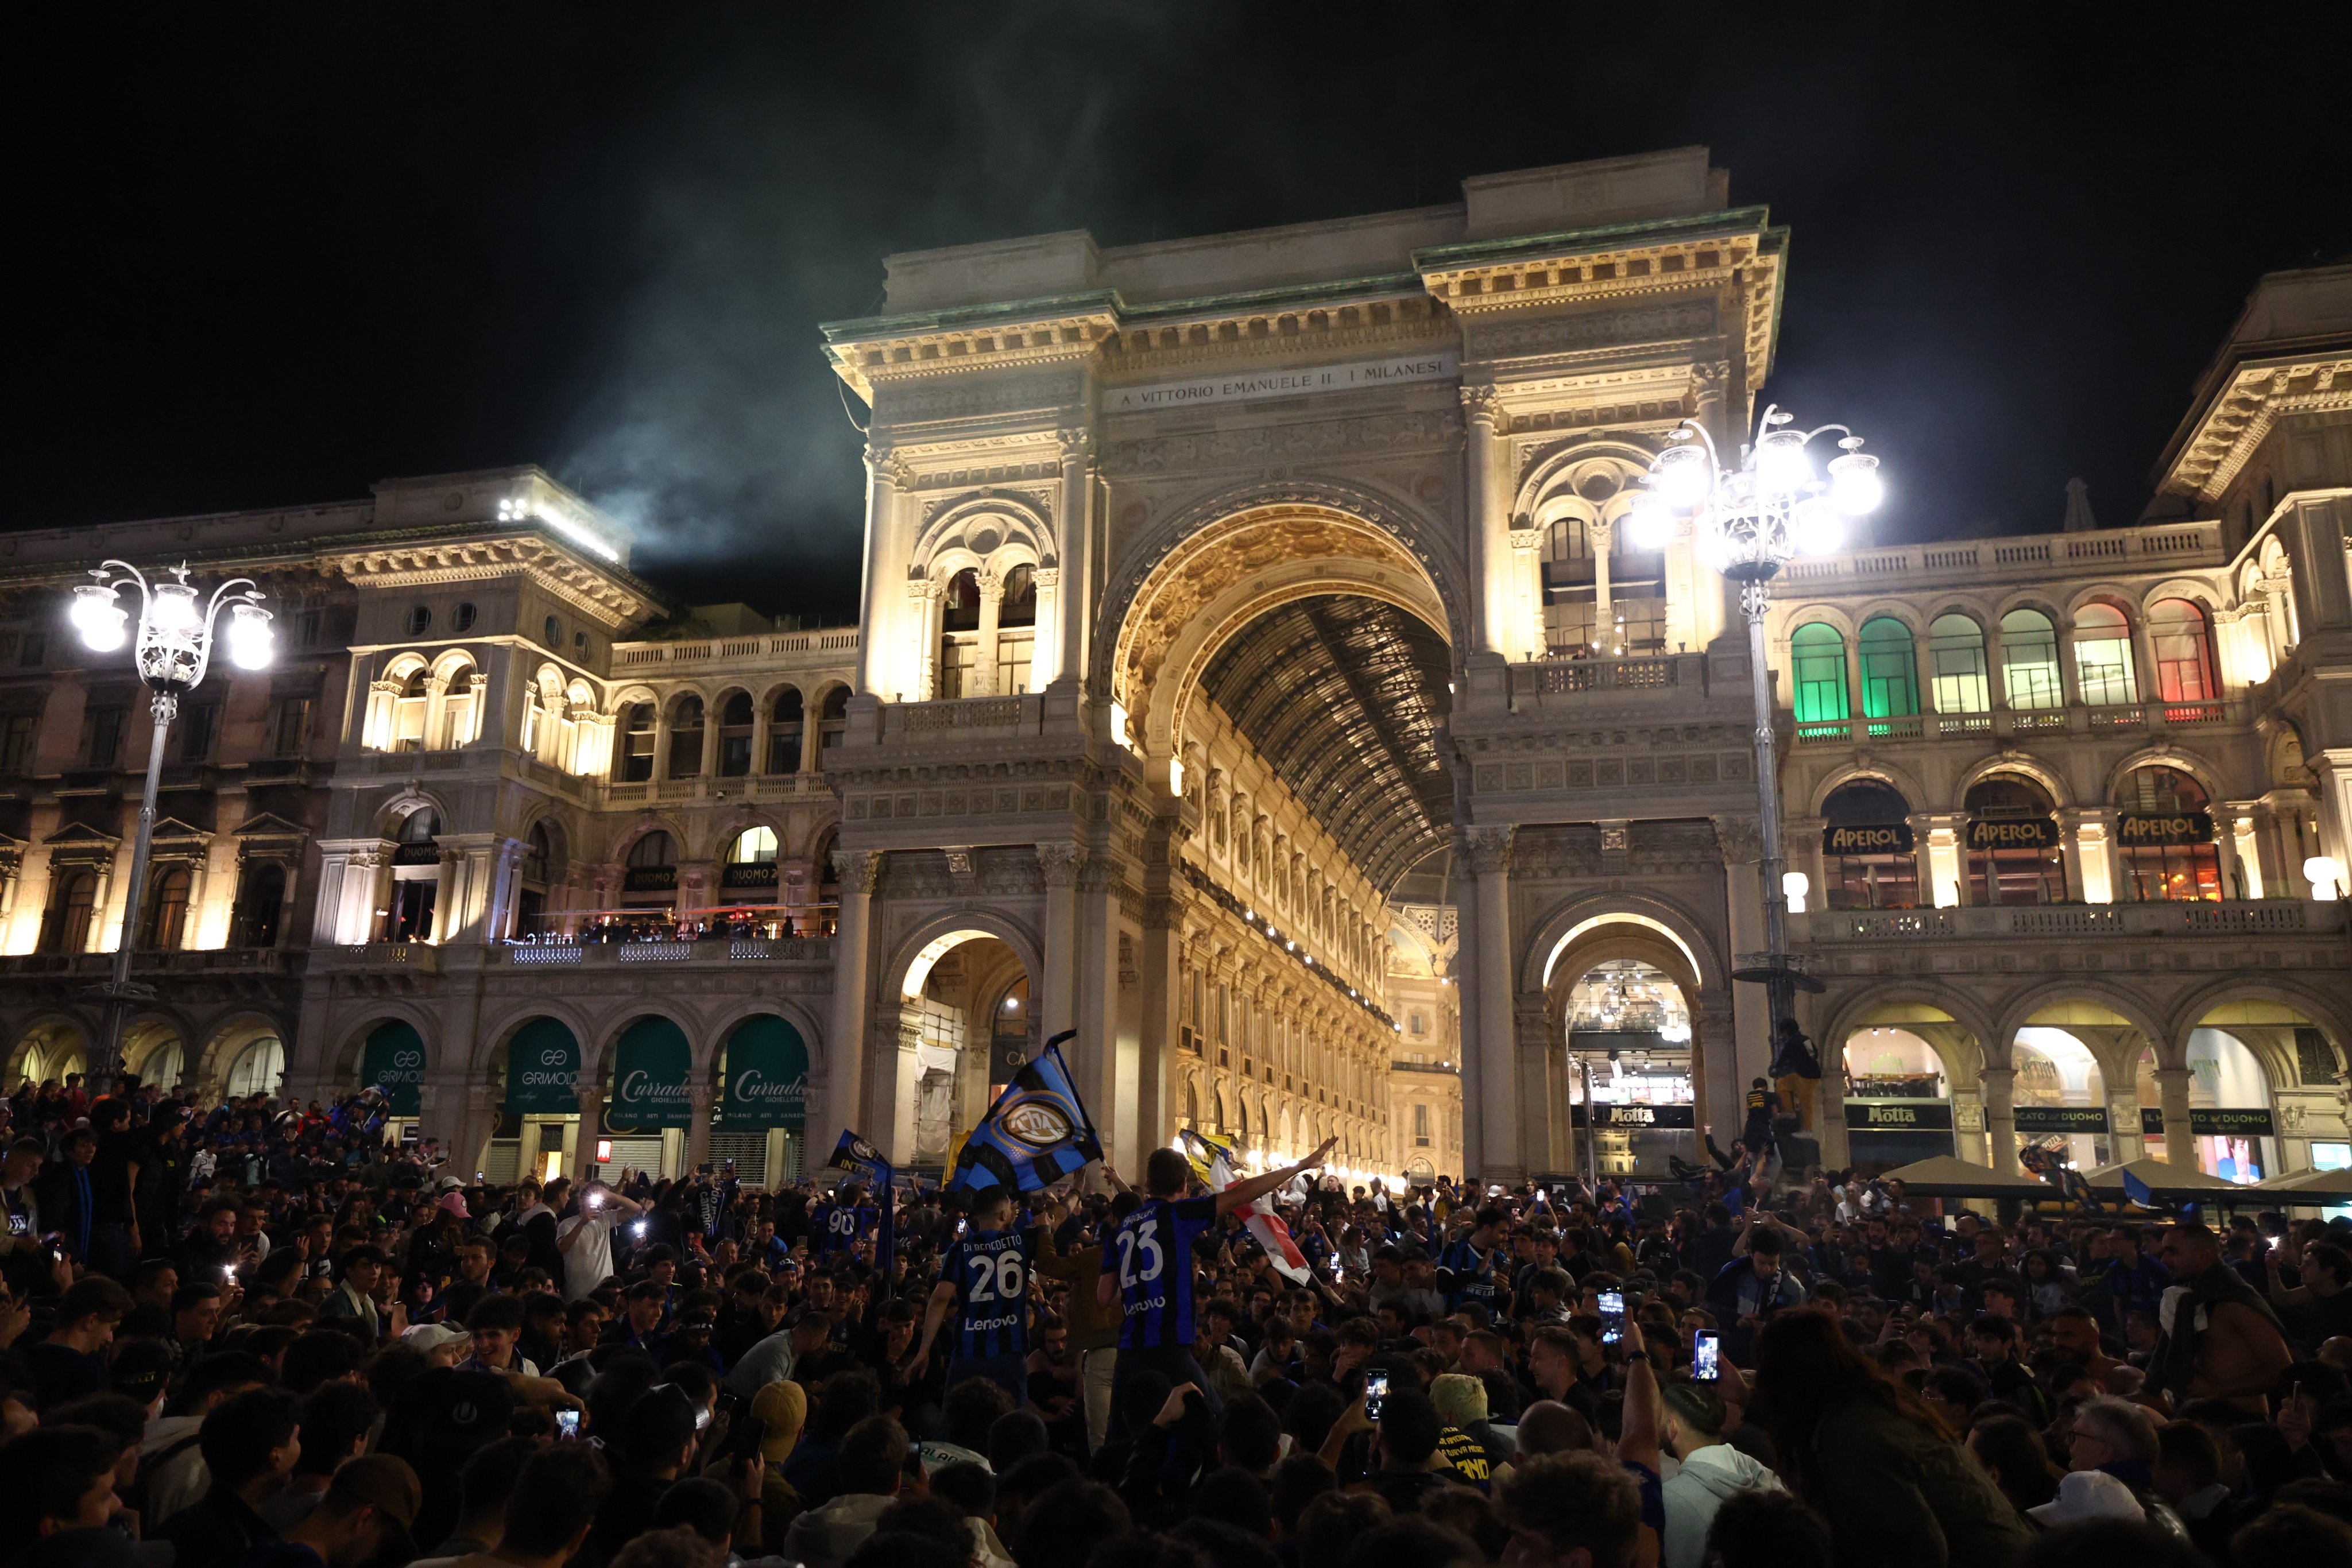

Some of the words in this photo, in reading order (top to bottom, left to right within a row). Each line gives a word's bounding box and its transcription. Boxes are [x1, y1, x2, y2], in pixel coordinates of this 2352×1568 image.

[1121, 395, 1131, 405] A
[1142, 386, 1214, 402] VITTORIO
[1223, 375, 1311, 395] EMANUELE
[1365, 361, 1442, 380] MILANESI
[1974, 822, 2047, 841] APEROL
[2123, 816, 2200, 837] APEROL
[1832, 828, 1902, 847] APEROL
[635, 873, 670, 883] DUOMO
[732, 869, 769, 880] DUOMO
[1610, 1107, 1655, 1123] Motta
[1868, 1107, 1916, 1122] Motta
[2061, 1113, 2103, 1121] DUOMO
[2223, 1114, 2267, 1123] DUOMO
[598, 1141, 612, 1158] M
[2042, 1135, 2063, 1149] PIZZA
[828, 1210, 855, 1236] 90
[964, 1243, 972, 1252] DI
[974, 1234, 1022, 1251] BENEDETTO
[1116, 1219, 1163, 1289] 23
[968, 1250, 1023, 1302] 26
[965, 1314, 1018, 1331] Lenovo
